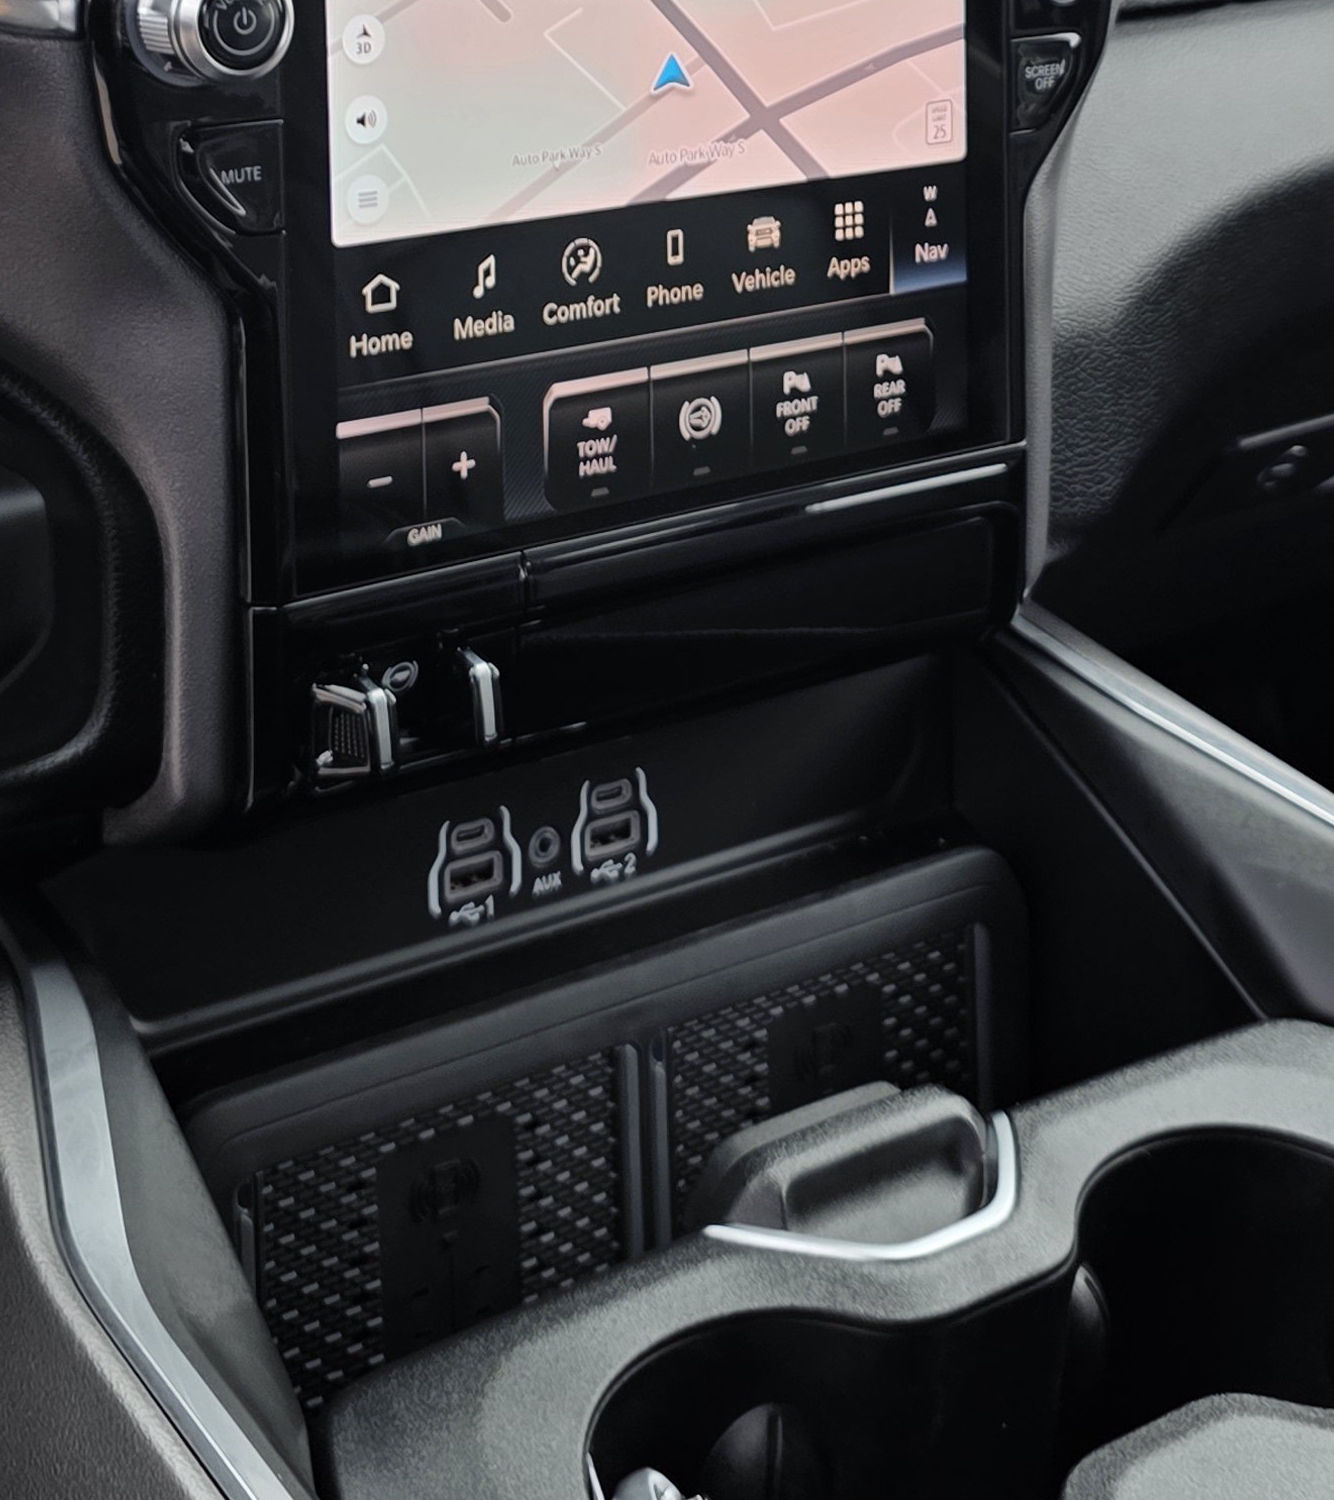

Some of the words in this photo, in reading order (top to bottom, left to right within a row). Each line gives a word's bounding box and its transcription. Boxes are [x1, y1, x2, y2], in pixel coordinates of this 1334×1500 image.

[355, 41, 372, 56] 3D
[1024, 63, 1062, 79] SCREEN
[1034, 75, 1056, 91] OFF
[933, 123, 947, 140] 25
[511, 152, 540, 168] Auto
[540, 149, 566, 163] Park
[568, 147, 594, 161] Way
[594, 144, 603, 157] S
[648, 152, 678, 166] Auto
[679, 148, 705, 162] Park
[707, 144, 736, 161] Way
[736, 141, 746, 155] S
[220, 164, 263, 185] MUTE
[922, 184, 939, 203] W
[914, 241, 950, 264] Nav
[826, 253, 872, 281] Apps
[730, 264, 797, 295] Vehicle
[646, 280, 705, 309] Phone
[542, 292, 621, 326] Comfort
[453, 309, 515, 341] Media
[348, 326, 413, 359] Home
[873, 378, 906, 399] REAR
[775, 395, 819, 418] FRONT
[877, 397, 903, 418] OFF
[784, 416, 811, 436] OFF
[576, 433, 618, 458] TOW/
[578, 456, 618, 478] HAUL
[406, 523, 443, 547] GAIN
[624, 852, 637, 876] 2
[532, 870, 563, 896] AUX
